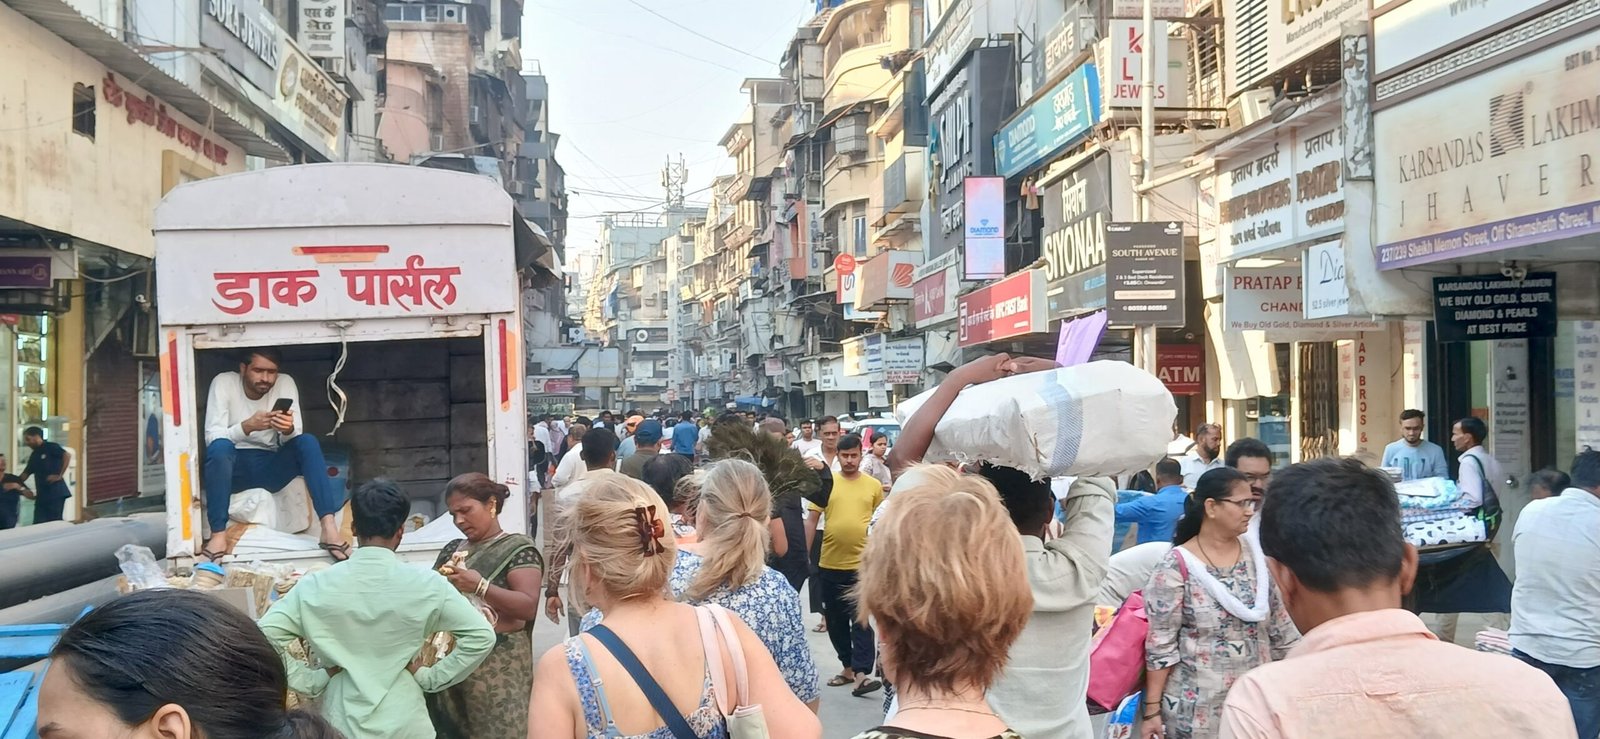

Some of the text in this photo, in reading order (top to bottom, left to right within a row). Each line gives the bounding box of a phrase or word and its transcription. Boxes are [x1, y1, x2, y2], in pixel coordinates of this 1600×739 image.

[241, 13, 277, 70] JEWELS
[1304, 129, 1335, 158] प्रताप
[1399, 131, 1484, 184] KARSANDAS
[1230, 161, 1254, 186] प्रताप
[970, 226, 999, 234] DIAMOND
[1408, 241, 1433, 258] Sheikh
[1434, 236, 1461, 252] Memon
[1462, 230, 1490, 247] Street,
[1491, 224, 1507, 241] Off
[1507, 216, 1557, 239] Shamsheth
[1558, 209, 1591, 231] Street,
[1045, 212, 1106, 281] SIYONAA
[1112, 248, 1178, 257] SOUTH AVENUE
[211, 254, 462, 315] डाक पार्सल
[1233, 276, 1292, 290] PRATAP
[1438, 281, 1483, 292] KARSANDAS
[1439, 293, 1552, 306] WE BUY OLD GOLD, SILVER,
[1455, 307, 1538, 320] DIAMOND & PEARLS
[1244, 321, 1257, 330] Buy
[1274, 321, 1291, 329] Gold,
[1353, 320, 1379, 328] Articles
[1467, 323, 1527, 335] AT BEST PRICE
[1158, 366, 1200, 382] ATM
